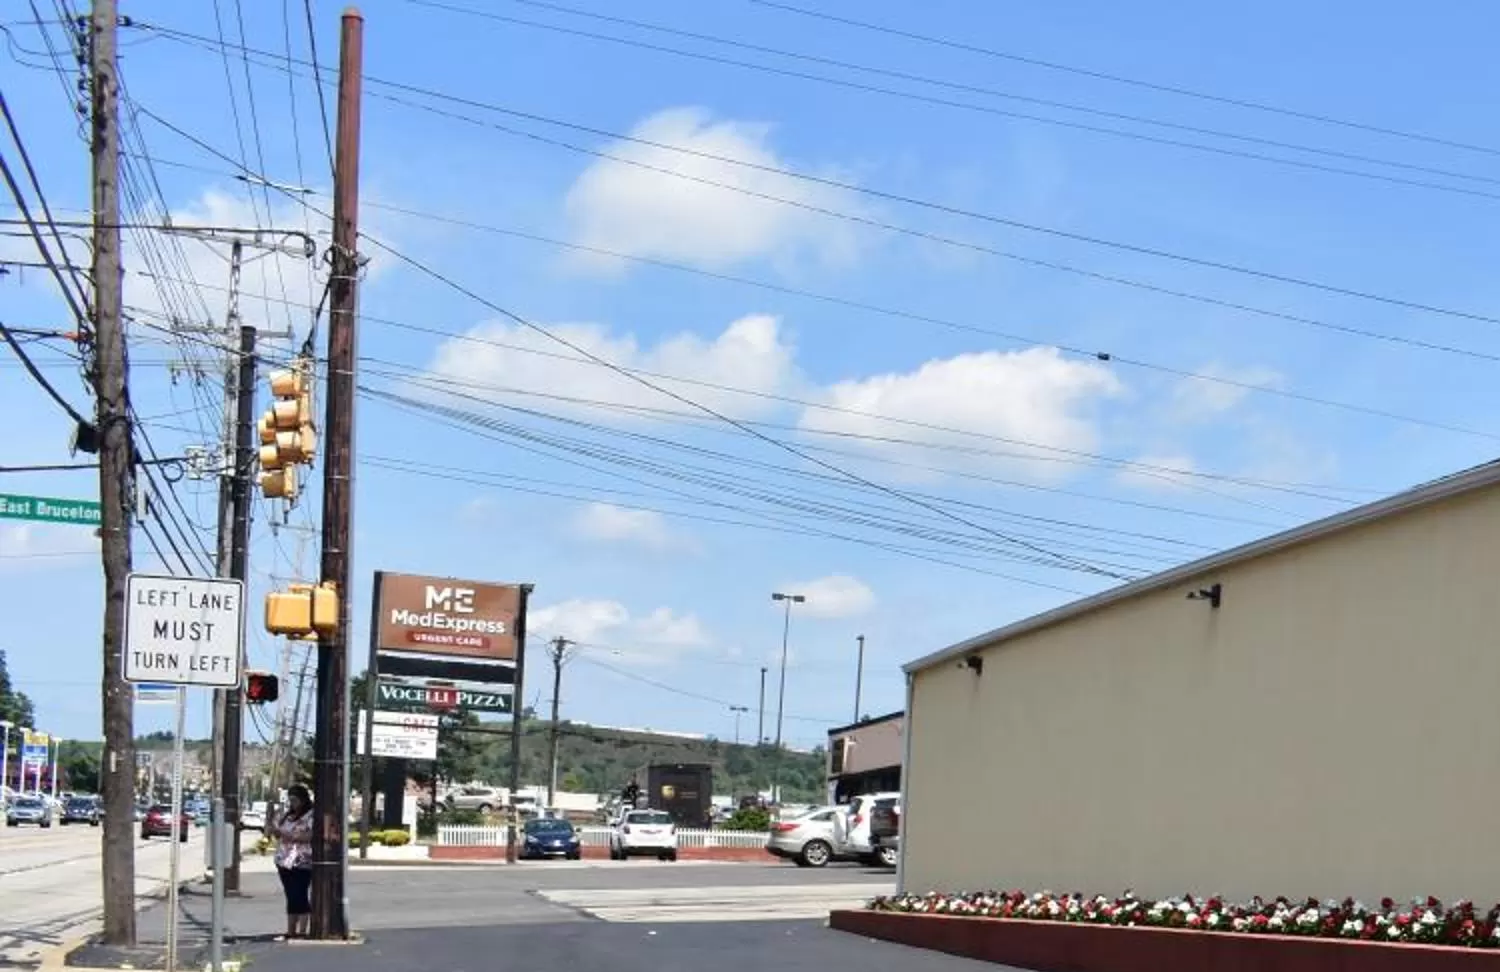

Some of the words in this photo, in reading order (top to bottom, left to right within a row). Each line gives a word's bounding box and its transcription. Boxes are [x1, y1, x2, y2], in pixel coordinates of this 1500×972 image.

[36, 501, 101, 521] Bruceton
[137, 590, 179, 607] LEFT
[189, 594, 233, 611] LANE
[153, 620, 215, 642] MUST
[391, 609, 506, 634] MedExpress
[134, 652, 179, 669] TURN
[189, 656, 232, 673] LEFT
[380, 685, 450, 704] VOCELLI
[455, 690, 506, 708] PIZZA
